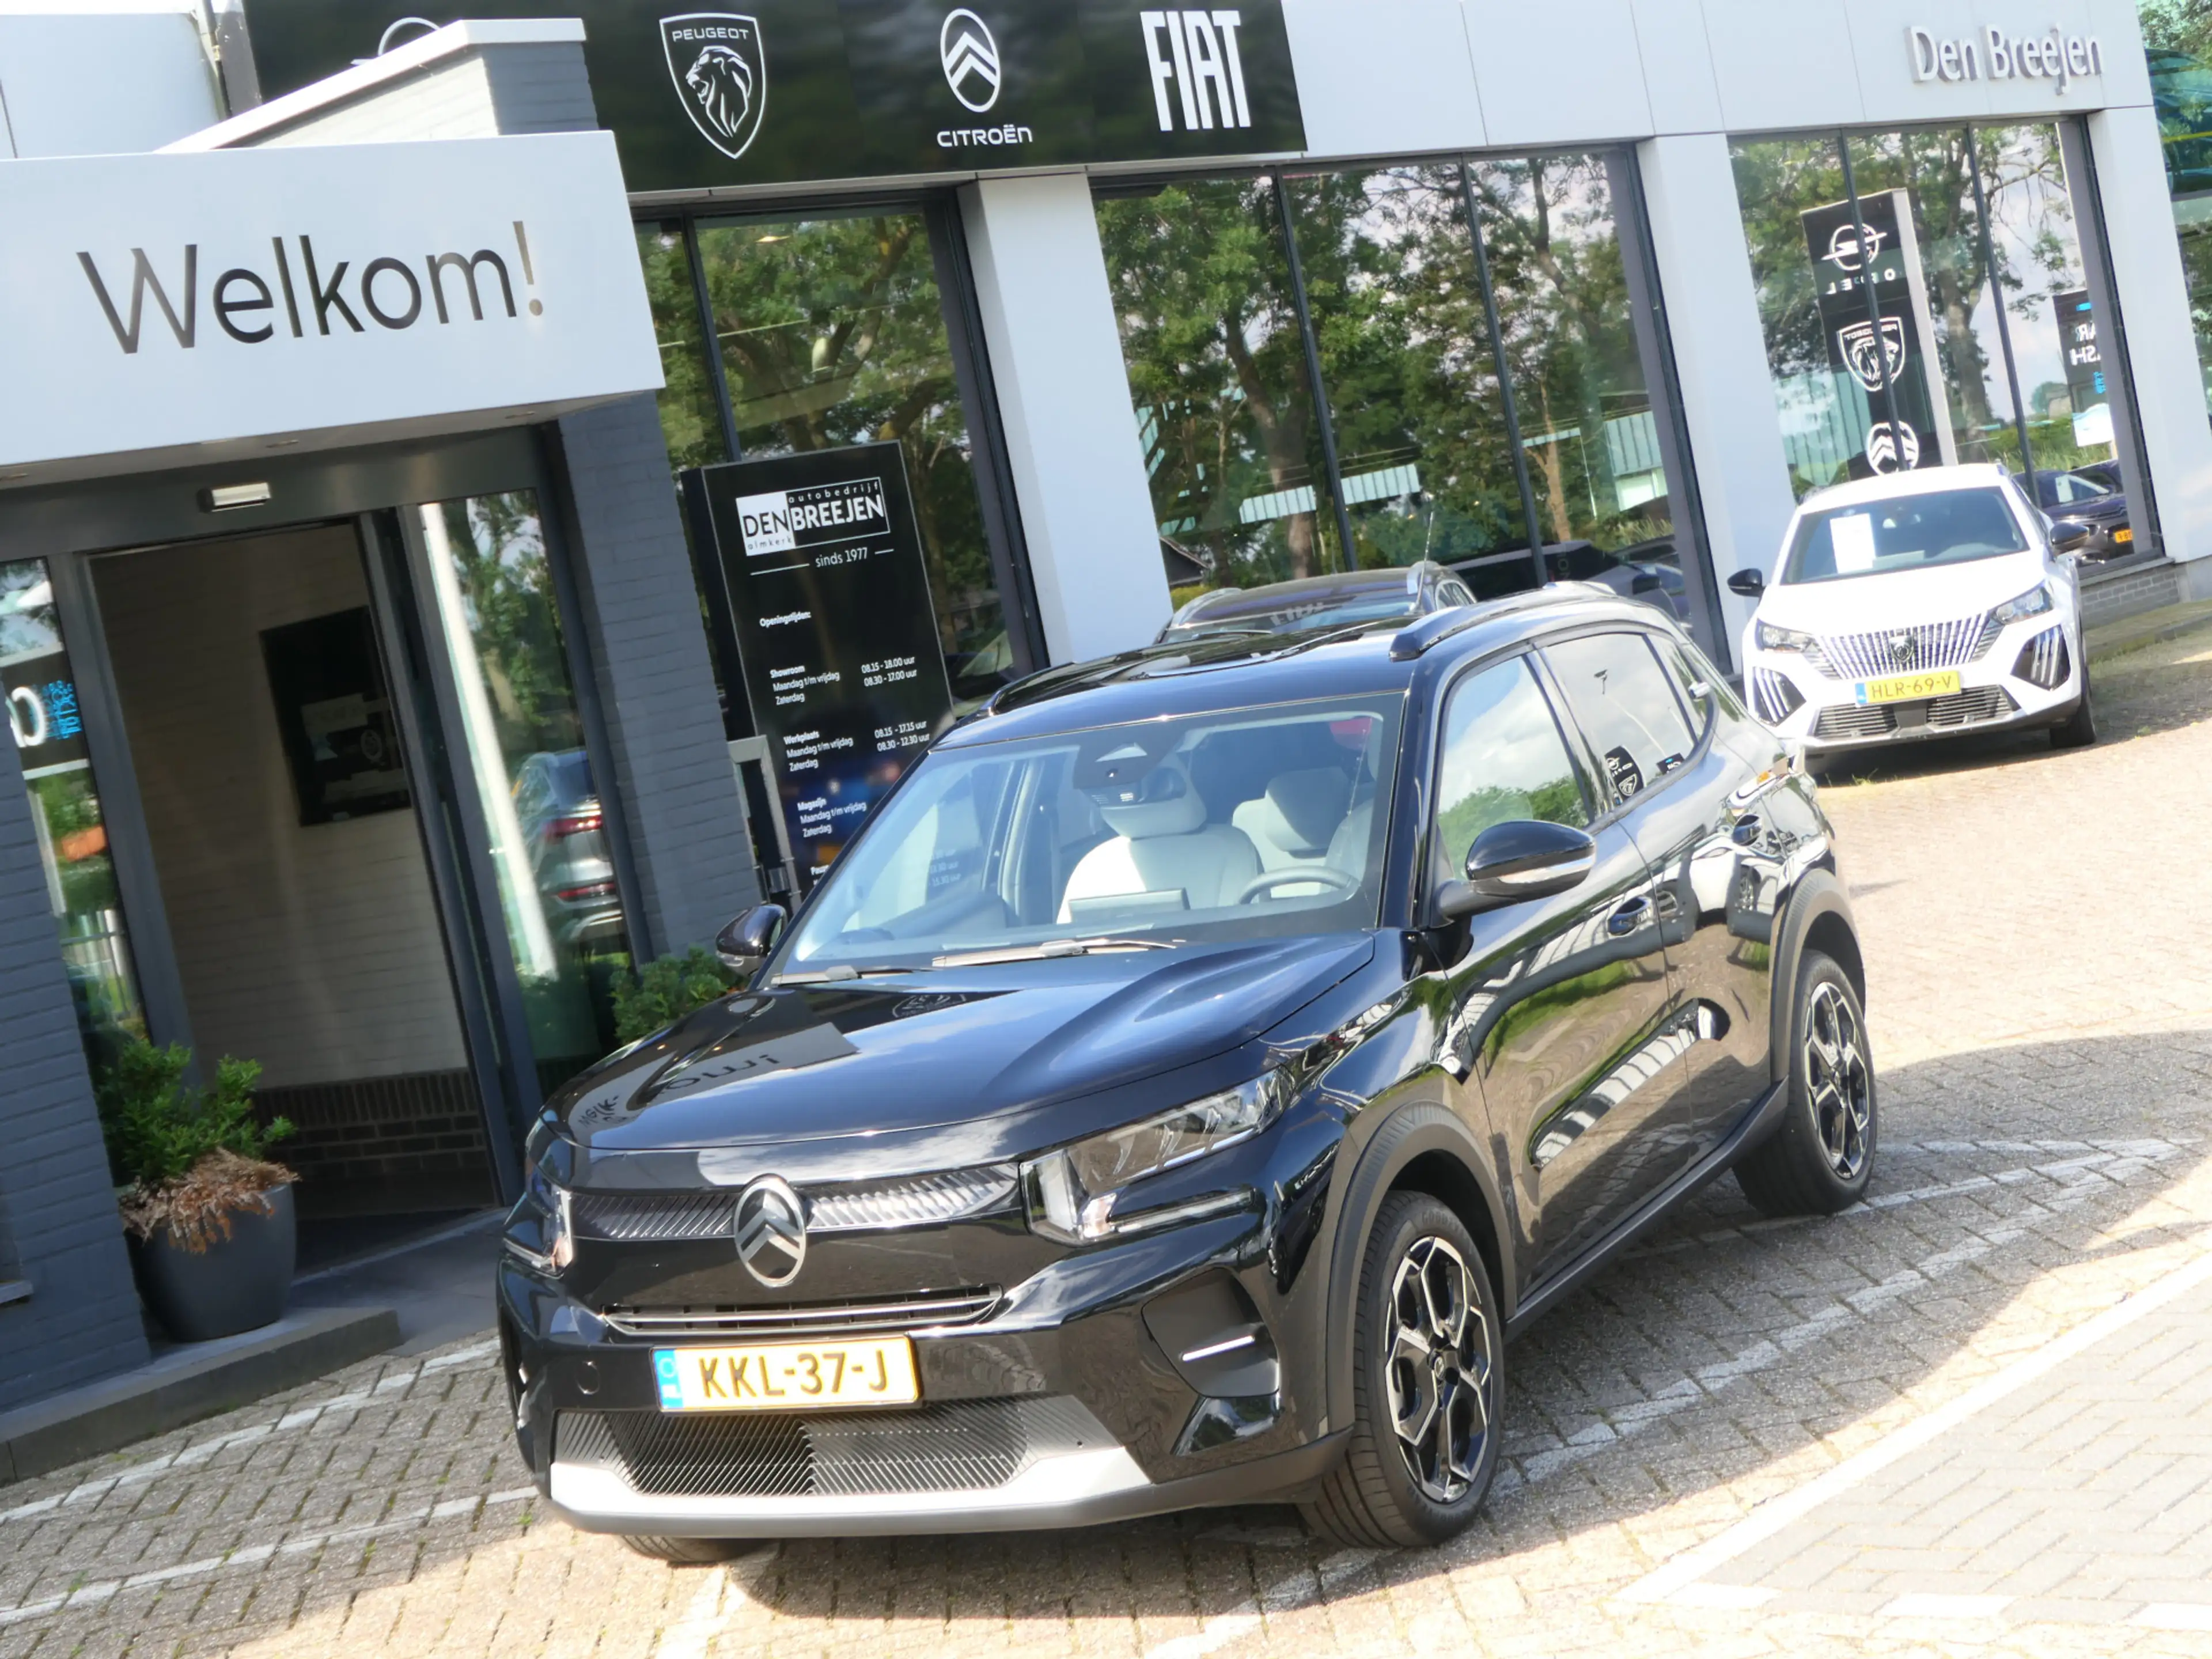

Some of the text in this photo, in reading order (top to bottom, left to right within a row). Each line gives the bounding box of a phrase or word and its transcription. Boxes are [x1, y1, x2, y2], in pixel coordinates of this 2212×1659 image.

[672, 28, 749, 41] PEUGEOT
[1903, 22, 2105, 95] Den Breejen
[1140, 10, 1251, 131] FIAT
[936, 124, 1033, 147] CITROËN
[77, 221, 544, 354] Welkom!
[789, 482, 878, 503] autobedrijf
[742, 494, 884, 537] DEN BREEJEN
[747, 536, 793, 550] almkerk
[816, 547, 868, 567] sinds 1977
[770, 665, 805, 679] Showroom
[861, 662, 880, 673] 08.15
[884, 657, 903, 669] 18.00
[903, 657, 915, 665] uur
[906, 669, 917, 678] uur
[772, 672, 840, 692] Maandag t/m vrijdag
[1872, 675, 1952, 699] HLR-69-V
[775, 693, 805, 705] Zaterdag
[915, 721, 927, 729] uur
[783, 730, 820, 745] Werkplaats
[918, 733, 930, 742] uur
[786, 745, 817, 758] Maandag
[830, 737, 854, 749] vrijdag
[789, 759, 819, 771] Zaterdag
[800, 811, 831, 824] Maandag
[802, 824, 832, 838] Zaterdag
[699, 1350, 888, 1399] KKL-37-J
